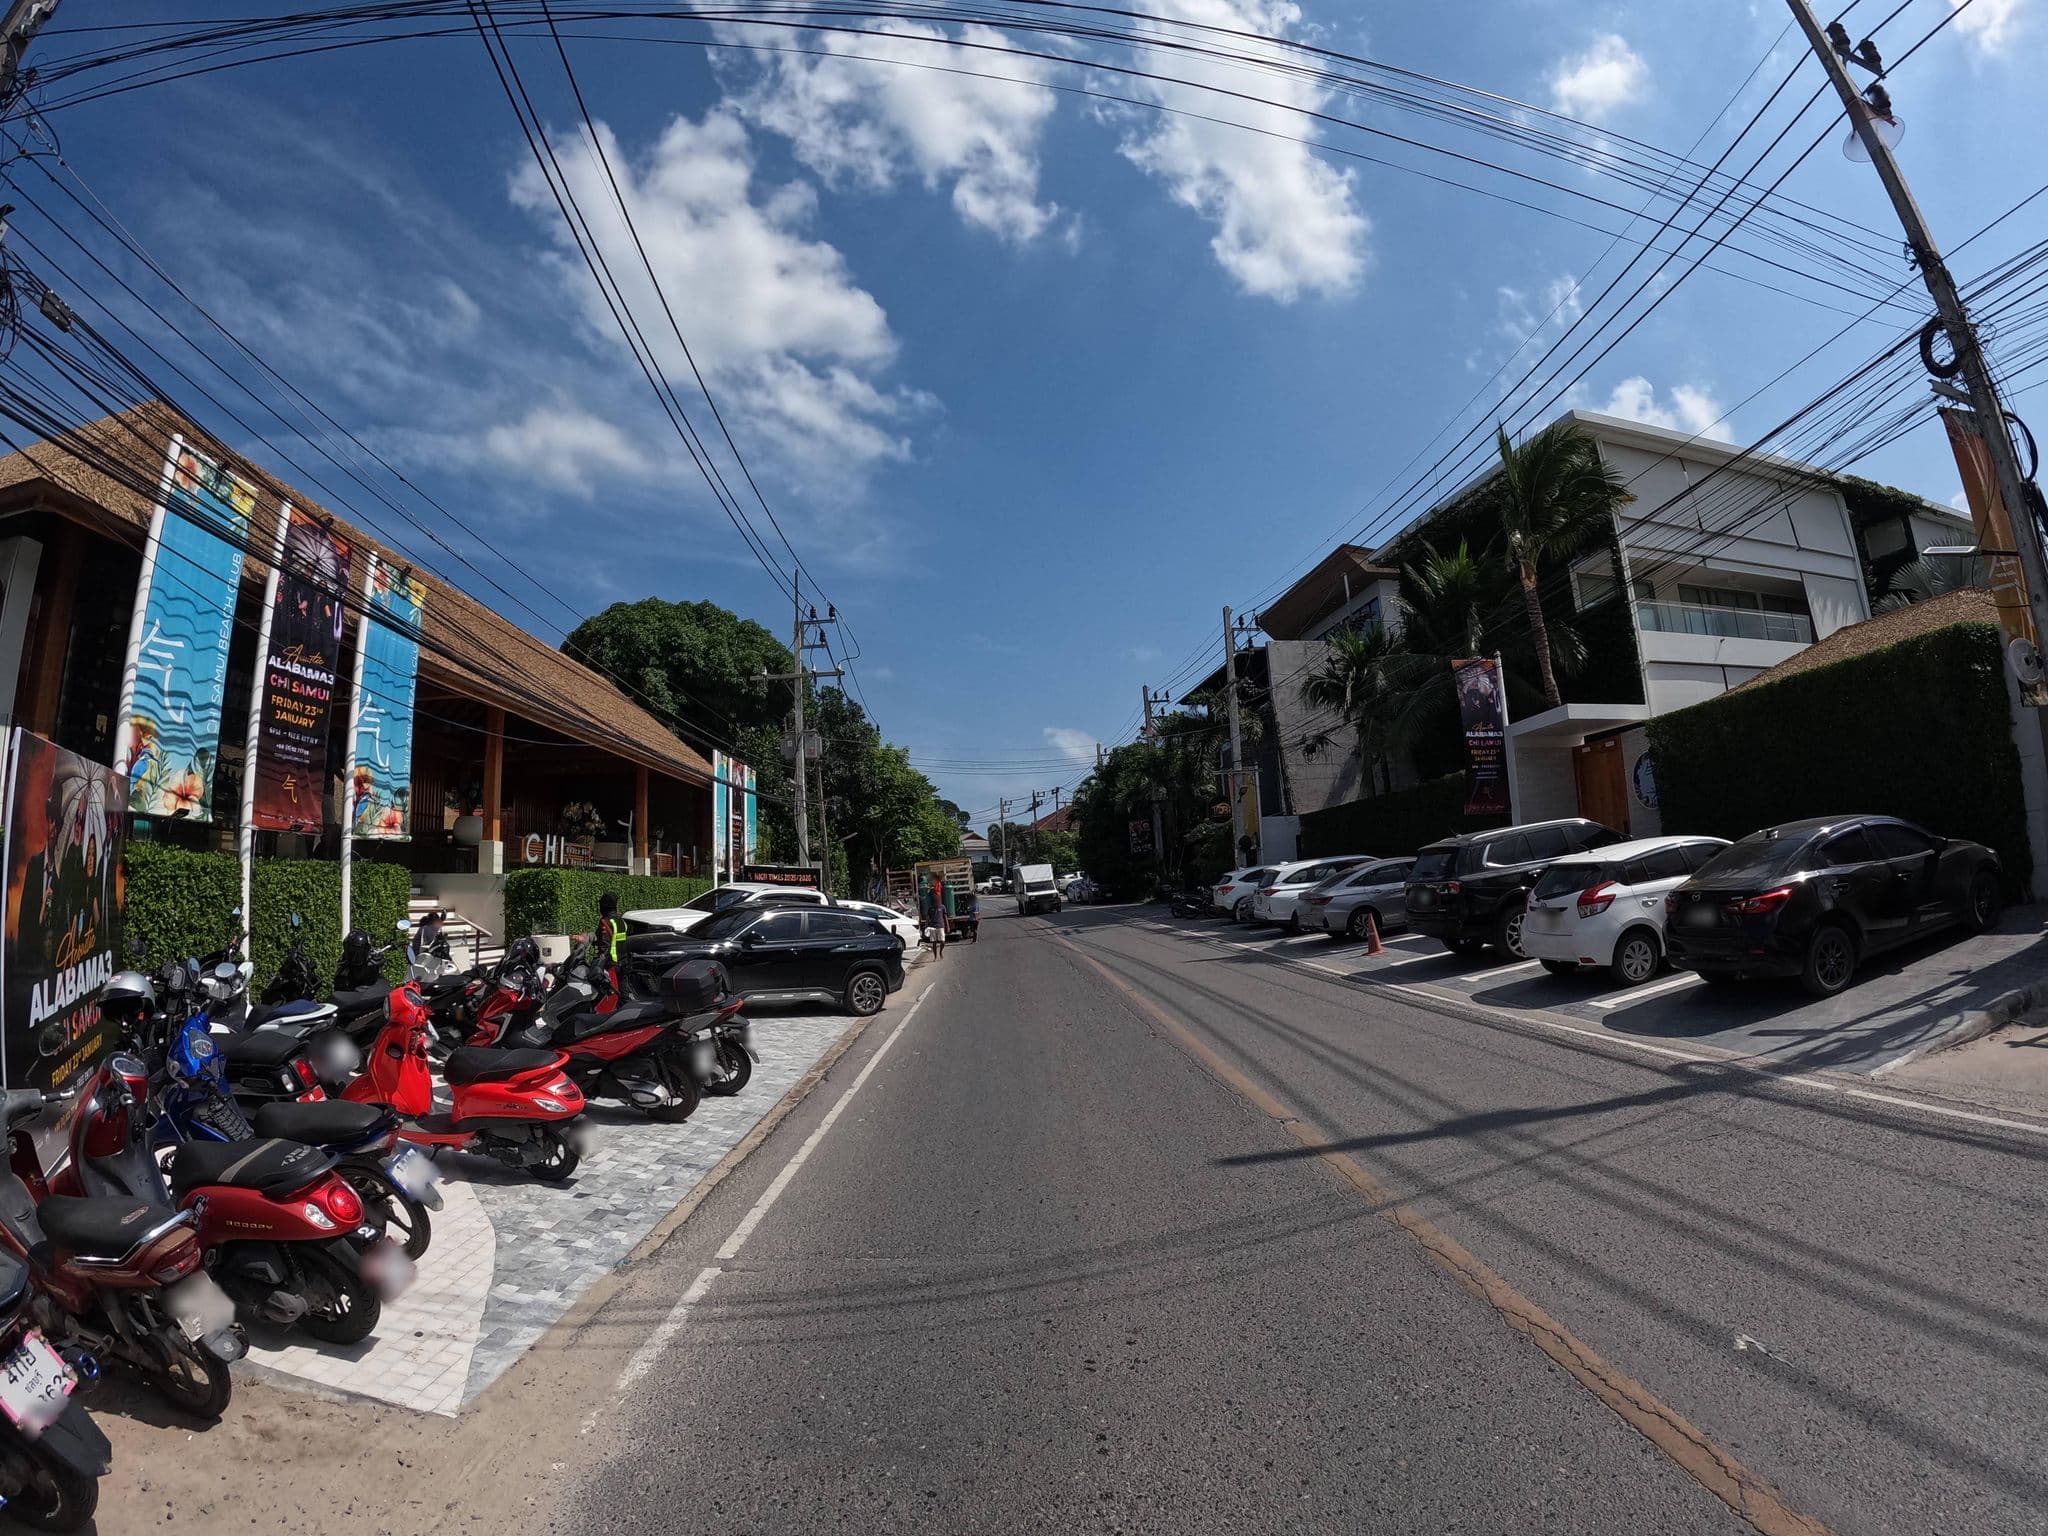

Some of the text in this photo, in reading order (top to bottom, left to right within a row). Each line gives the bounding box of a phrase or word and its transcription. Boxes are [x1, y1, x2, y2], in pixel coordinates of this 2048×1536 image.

[206, 553, 243, 734] CHI SAMUI BEACH CLUB
[268, 654, 335, 685] ALABAMA3
[270, 673, 330, 702] CHI SAMUI
[271, 694, 304, 713] FRIDAY
[275, 709, 316, 729] JANUARY
[526, 833, 564, 865] CHI
[29, 950, 113, 1028] ALABAMA3
[51, 1061, 73, 1089] FRIDAY
[80, 1033, 103, 1065] JANUARY
